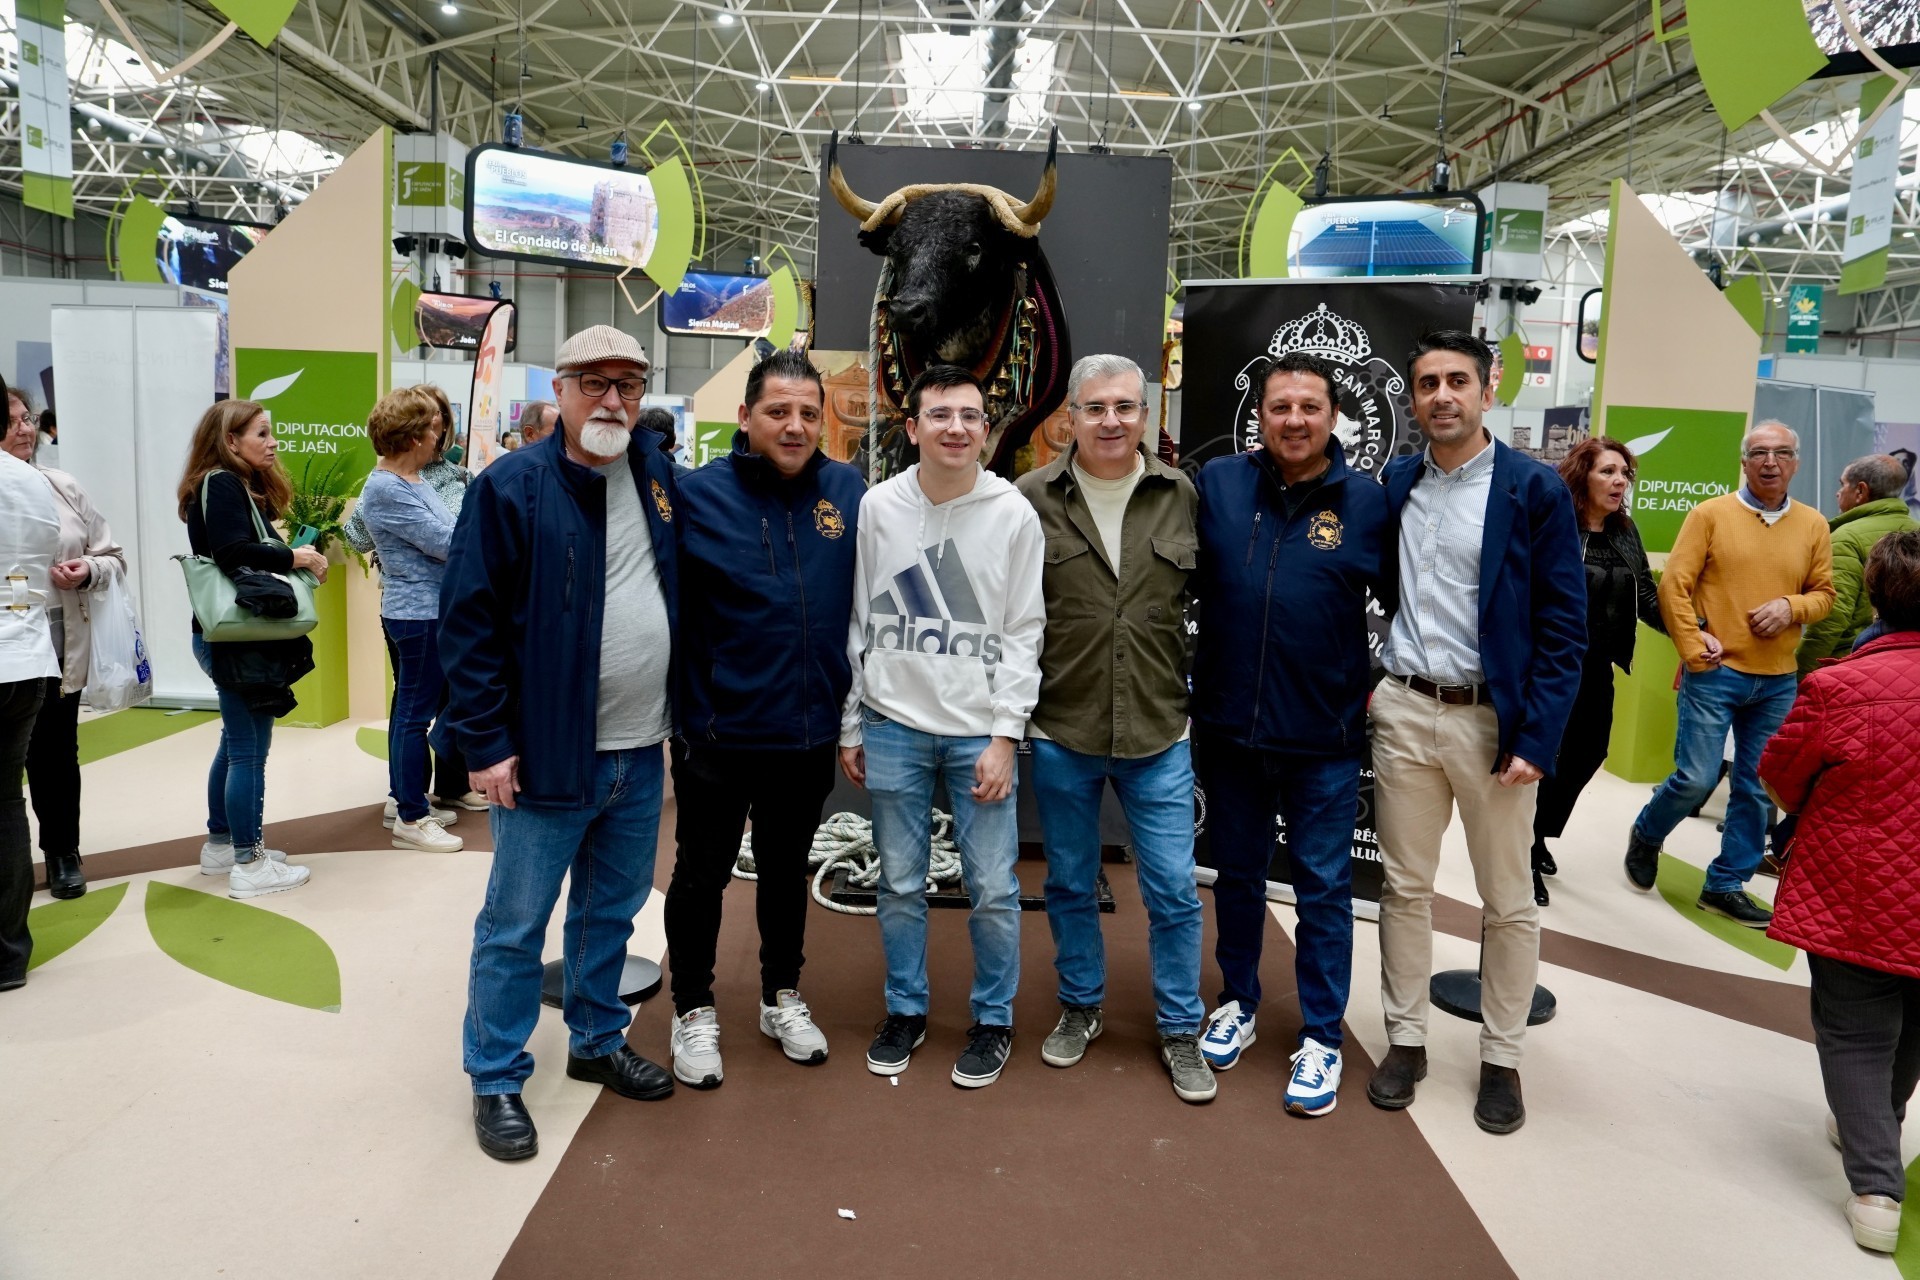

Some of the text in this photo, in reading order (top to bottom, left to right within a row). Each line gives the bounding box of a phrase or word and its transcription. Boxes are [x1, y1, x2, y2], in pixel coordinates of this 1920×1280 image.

[495, 230, 618, 257] El Condado de Jaén
[688, 318, 740, 330] Sierra Mágina
[460, 335, 476, 345] Jaén
[1332, 368, 1367, 398] SAN
[1356, 398, 1382, 472] MARCO
[276, 422, 368, 438] DIPUTACIÓN
[276, 439, 337, 454] DE JAÉN
[1639, 480, 1730, 496] DIPUTACIÓN
[1637, 497, 1697, 511] DE JAÉN
